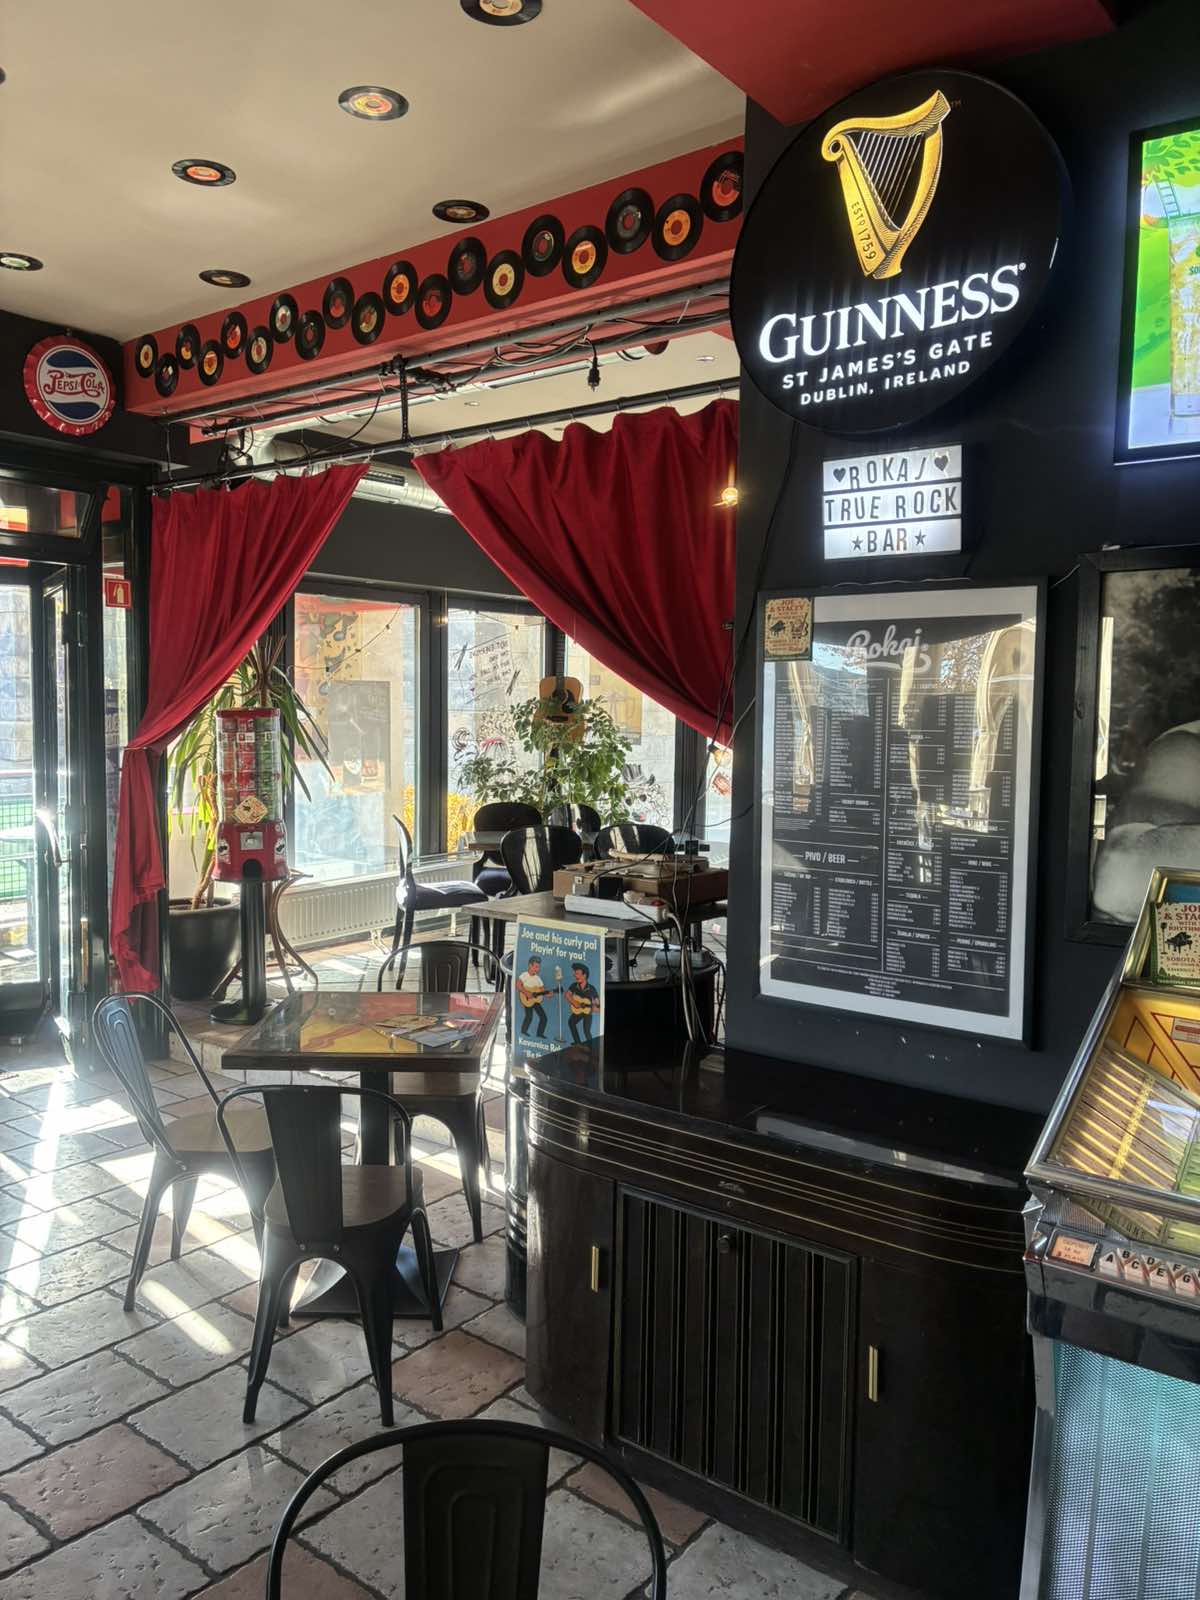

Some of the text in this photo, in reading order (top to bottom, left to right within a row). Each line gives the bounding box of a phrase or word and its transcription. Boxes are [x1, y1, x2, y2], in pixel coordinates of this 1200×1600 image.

[858, 227, 876, 259] 1759
[782, 372, 808, 389] ST
[929, 331, 993, 359] GATE
[801, 361, 970, 405] DUBLIN, IRELAND
[825, 486, 957, 522] TRUE ROCK
[867, 528, 907, 553] BAR
[805, 851, 821, 861] PIVO
[828, 853, 846, 864] BEER
[1184, 904, 1200, 912] JO
[521, 927, 597, 951] Joe and his curly pal
[556, 946, 567, 957] for
[569, 951, 586, 960] you!
[1106, 1254, 1114, 1263] A
[1122, 1250, 1131, 1259] B
[1131, 1261, 1140, 1270] C
[1147, 1257, 1155, 1266] D
[1157, 1268, 1166, 1277] E
[1183, 1275, 1191, 1284] G
